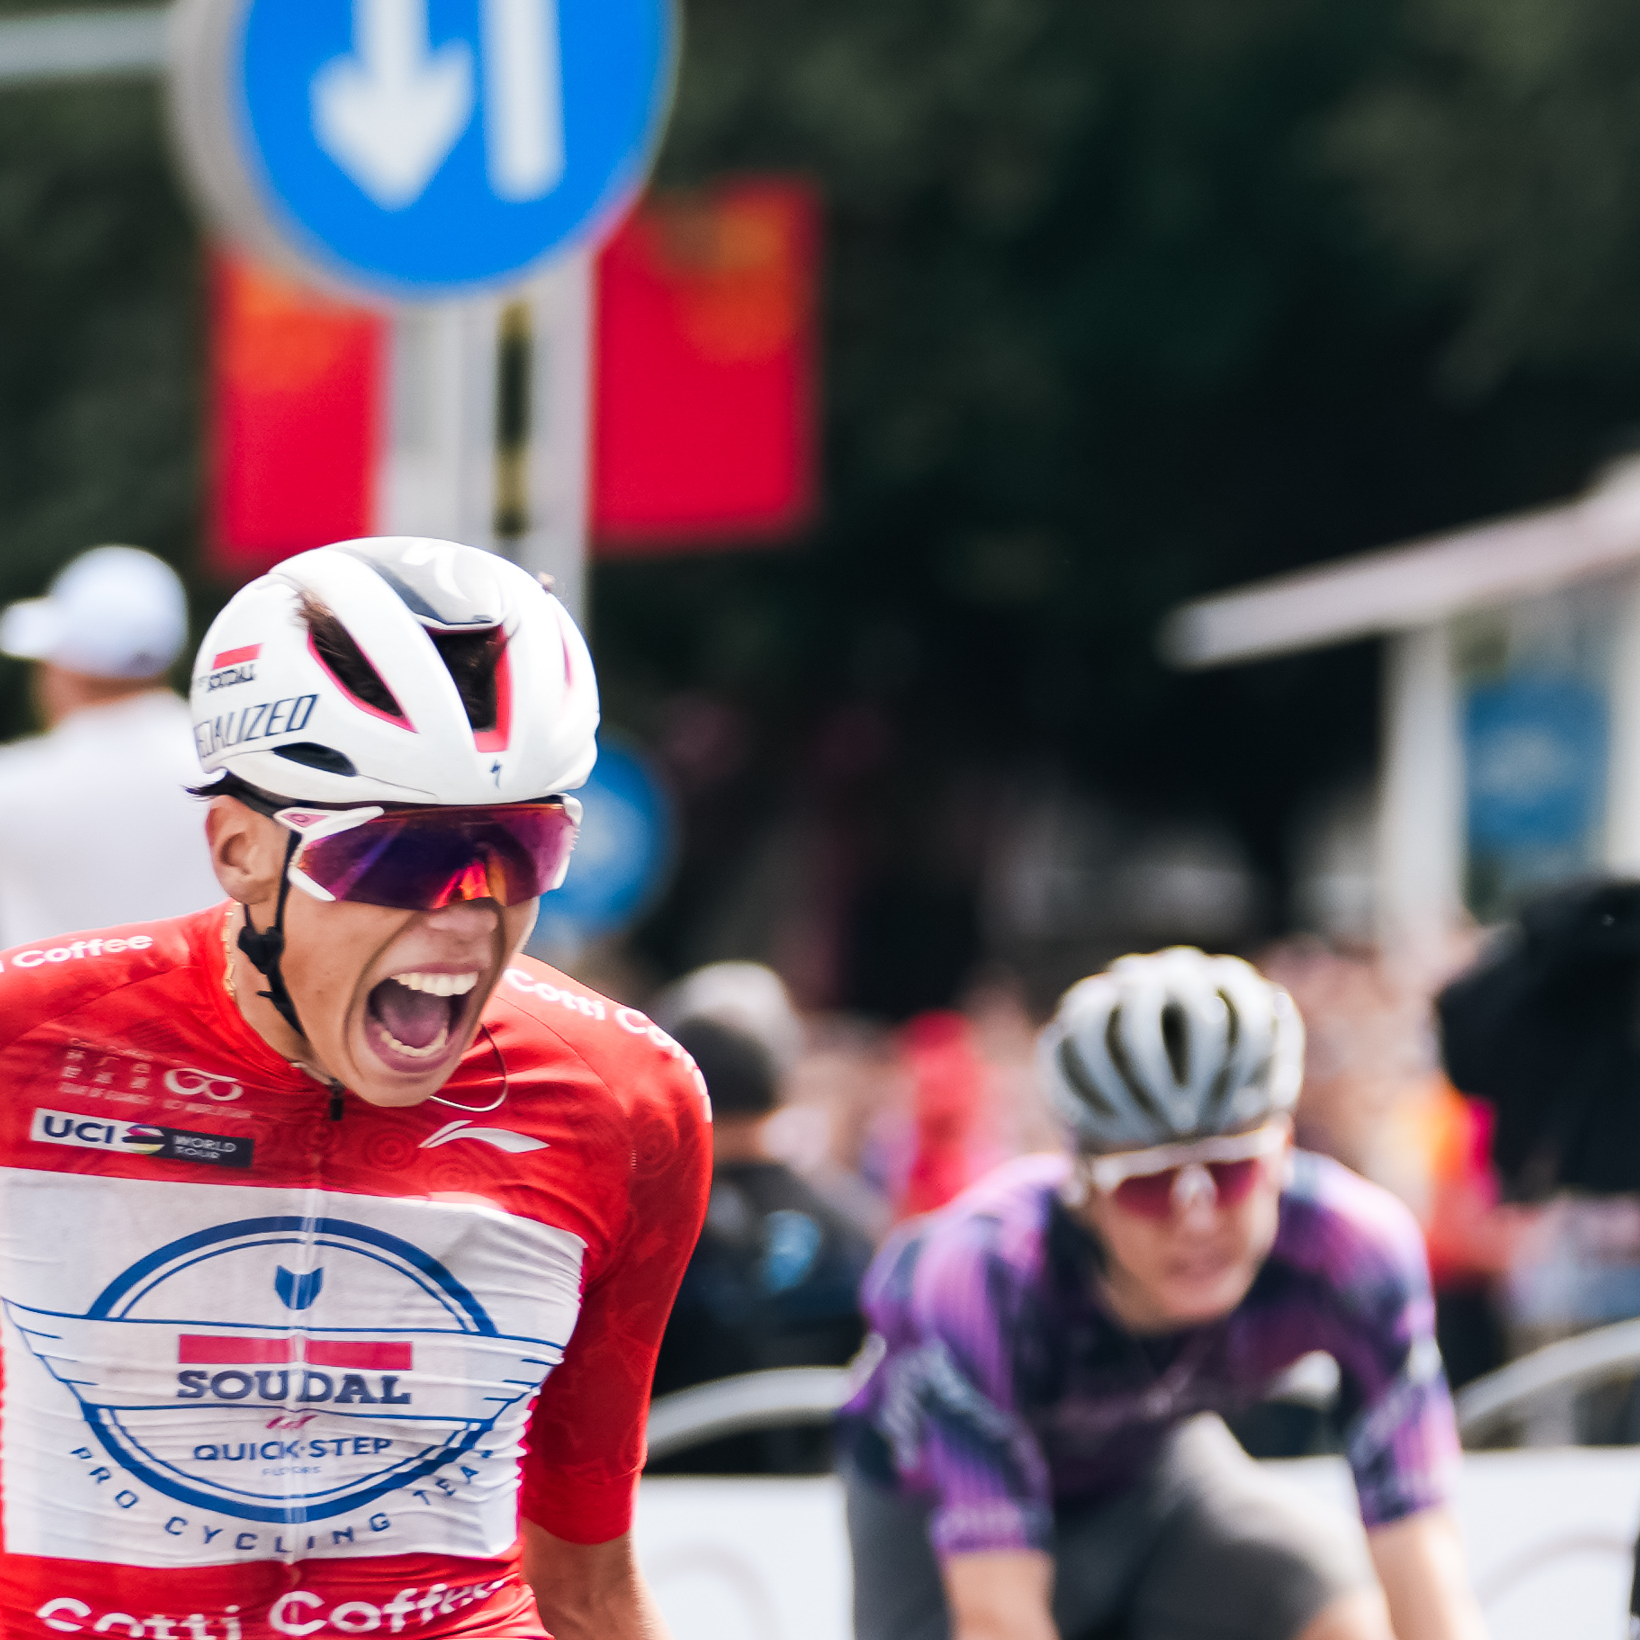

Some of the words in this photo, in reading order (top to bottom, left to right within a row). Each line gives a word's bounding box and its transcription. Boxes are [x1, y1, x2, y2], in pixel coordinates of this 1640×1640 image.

[12, 935, 153, 967] Coffee
[502, 968, 606, 1020] Cotti
[43, 1116, 116, 1144] UCI
[173, 1135, 237, 1152] WORLD
[174, 1145, 220, 1159] TOUR
[177, 1370, 412, 1404] SOUDAL
[70, 1446, 140, 1509] PRO
[164, 1512, 391, 1553] CYCLING
